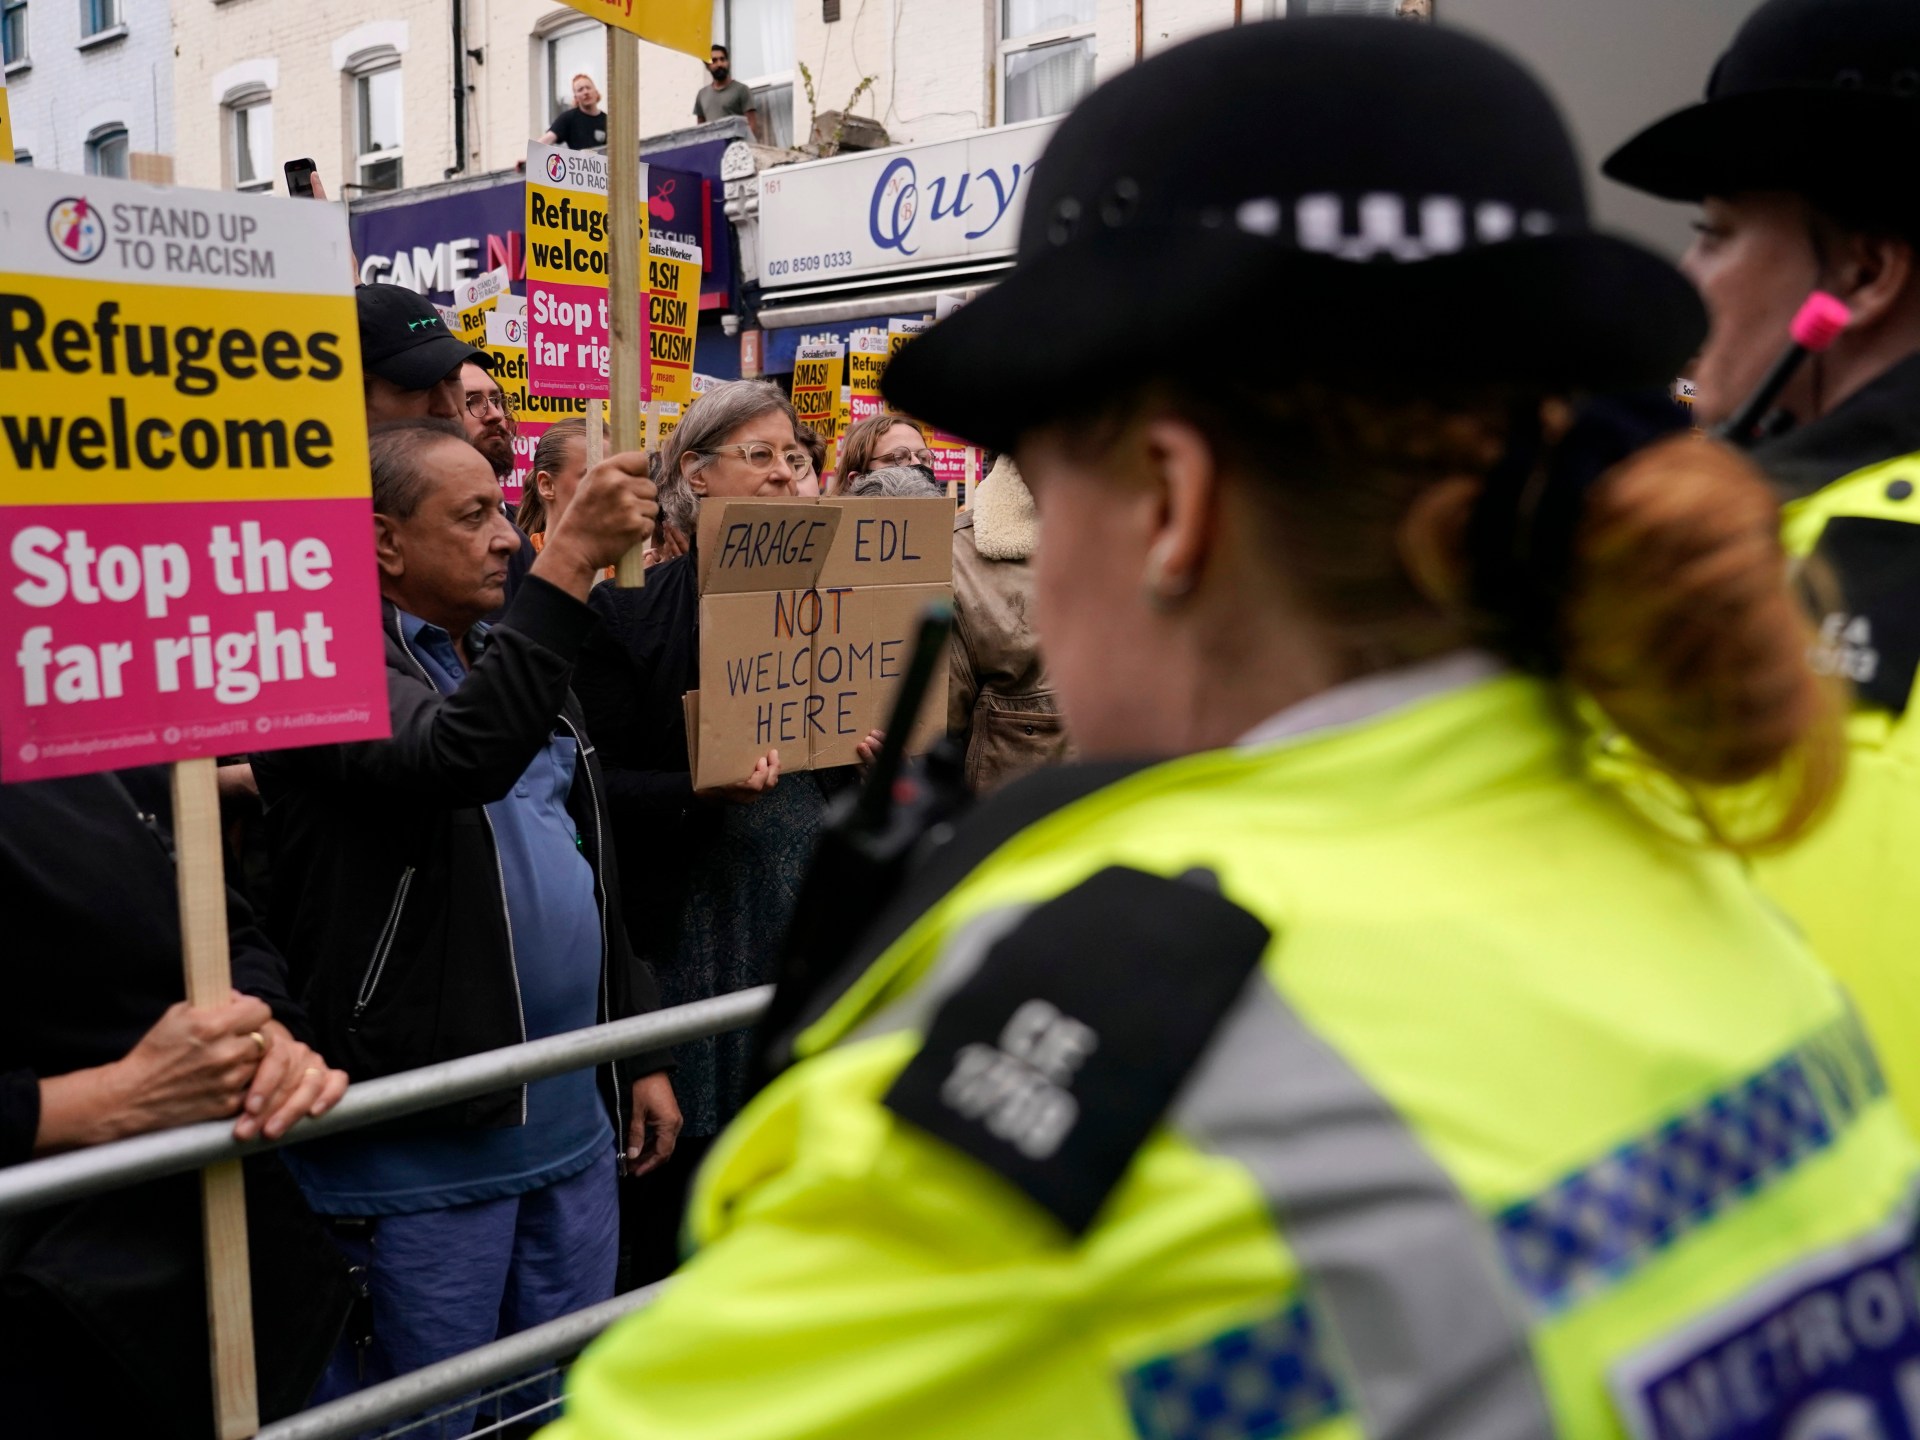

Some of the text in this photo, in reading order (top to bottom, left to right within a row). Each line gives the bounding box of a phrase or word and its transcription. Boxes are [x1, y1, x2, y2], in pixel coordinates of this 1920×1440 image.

[568, 156, 602, 175] STAND
[568, 171, 609, 191] TO RACI
[764, 179, 781, 194] 161
[112, 204, 257, 243] STAND UP
[531, 191, 643, 242] Refugs
[869, 156, 1038, 257] Quy
[531, 238, 609, 275] welco
[648, 243, 692, 261] ialist Worker
[665, 231, 698, 246] CLUB
[115, 238, 276, 279] TO RACISM
[360, 238, 480, 296] GAME
[649, 261, 680, 291] ASH
[768, 251, 852, 276] 020 8509 0333
[533, 289, 593, 336] Stop
[649, 296, 688, 328] CISM
[0, 293, 343, 396] Refugees
[533, 331, 570, 367] far
[577, 336, 611, 378] rig
[650, 331, 692, 363] ACISM
[656, 372, 676, 384] means
[795, 363, 829, 386] SMASH
[852, 356, 887, 375] Refuge
[513, 386, 589, 413] elcome
[792, 390, 833, 413] FASCISM
[1, 396, 334, 470] welcome
[511, 435, 541, 462] top
[719, 519, 921, 569] FARAGE EDL
[11, 520, 333, 618] Stop the
[774, 587, 854, 641] NOT
[17, 610, 337, 707] far right
[727, 639, 904, 696] WELCOME
[756, 691, 858, 744] HERE
[1655, 1260, 1920, 1440] METRO
